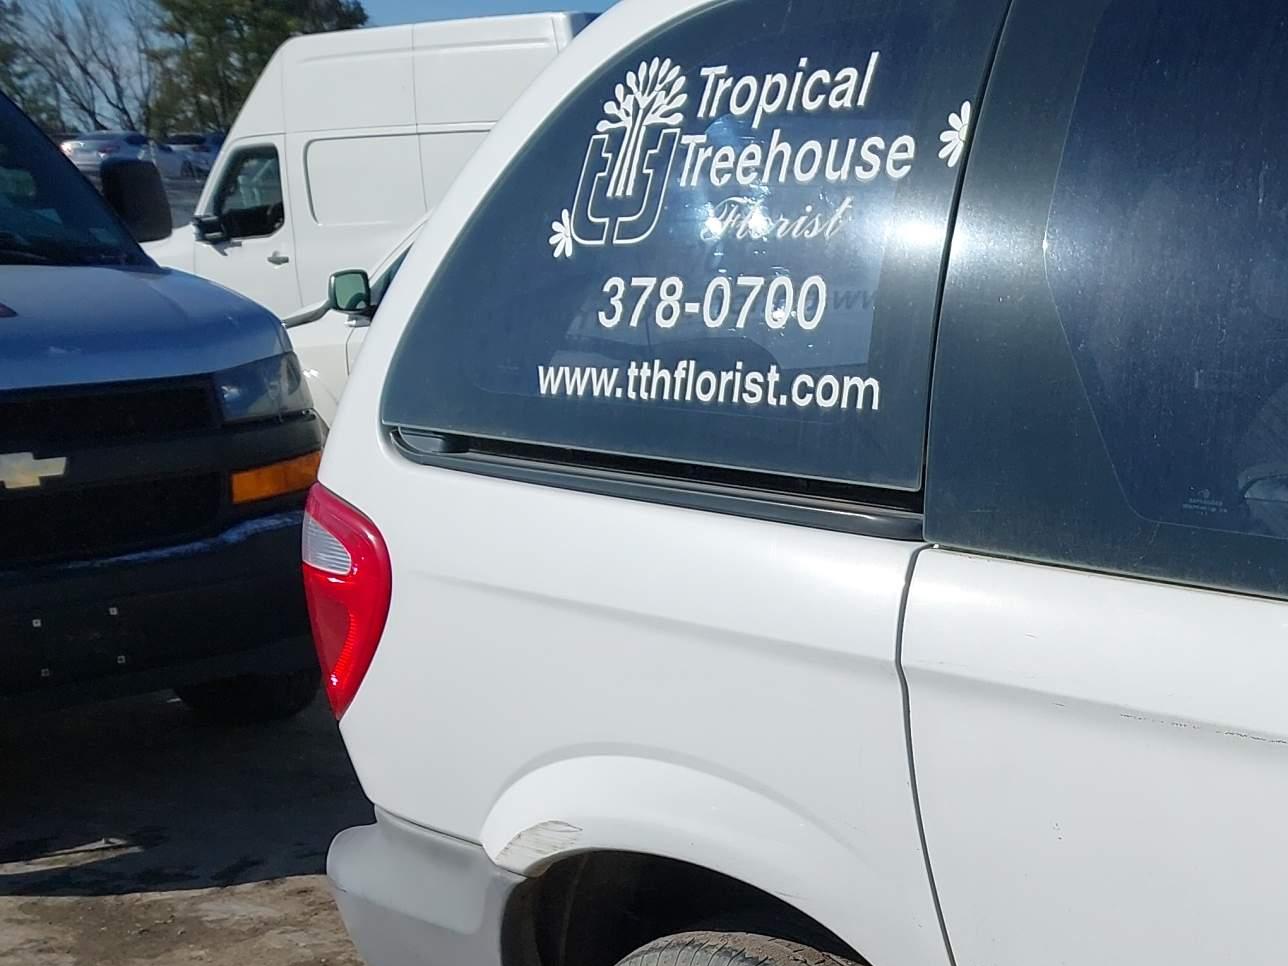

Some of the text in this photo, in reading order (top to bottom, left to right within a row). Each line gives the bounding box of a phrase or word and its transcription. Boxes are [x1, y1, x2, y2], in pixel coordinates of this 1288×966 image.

[696, 51, 881, 128] Tropical
[679, 127, 916, 187] Treehouse
[700, 195, 854, 240] Florist
[598, 274, 827, 330] 378-0700
[537, 360, 881, 410] www.tthflorist.com
